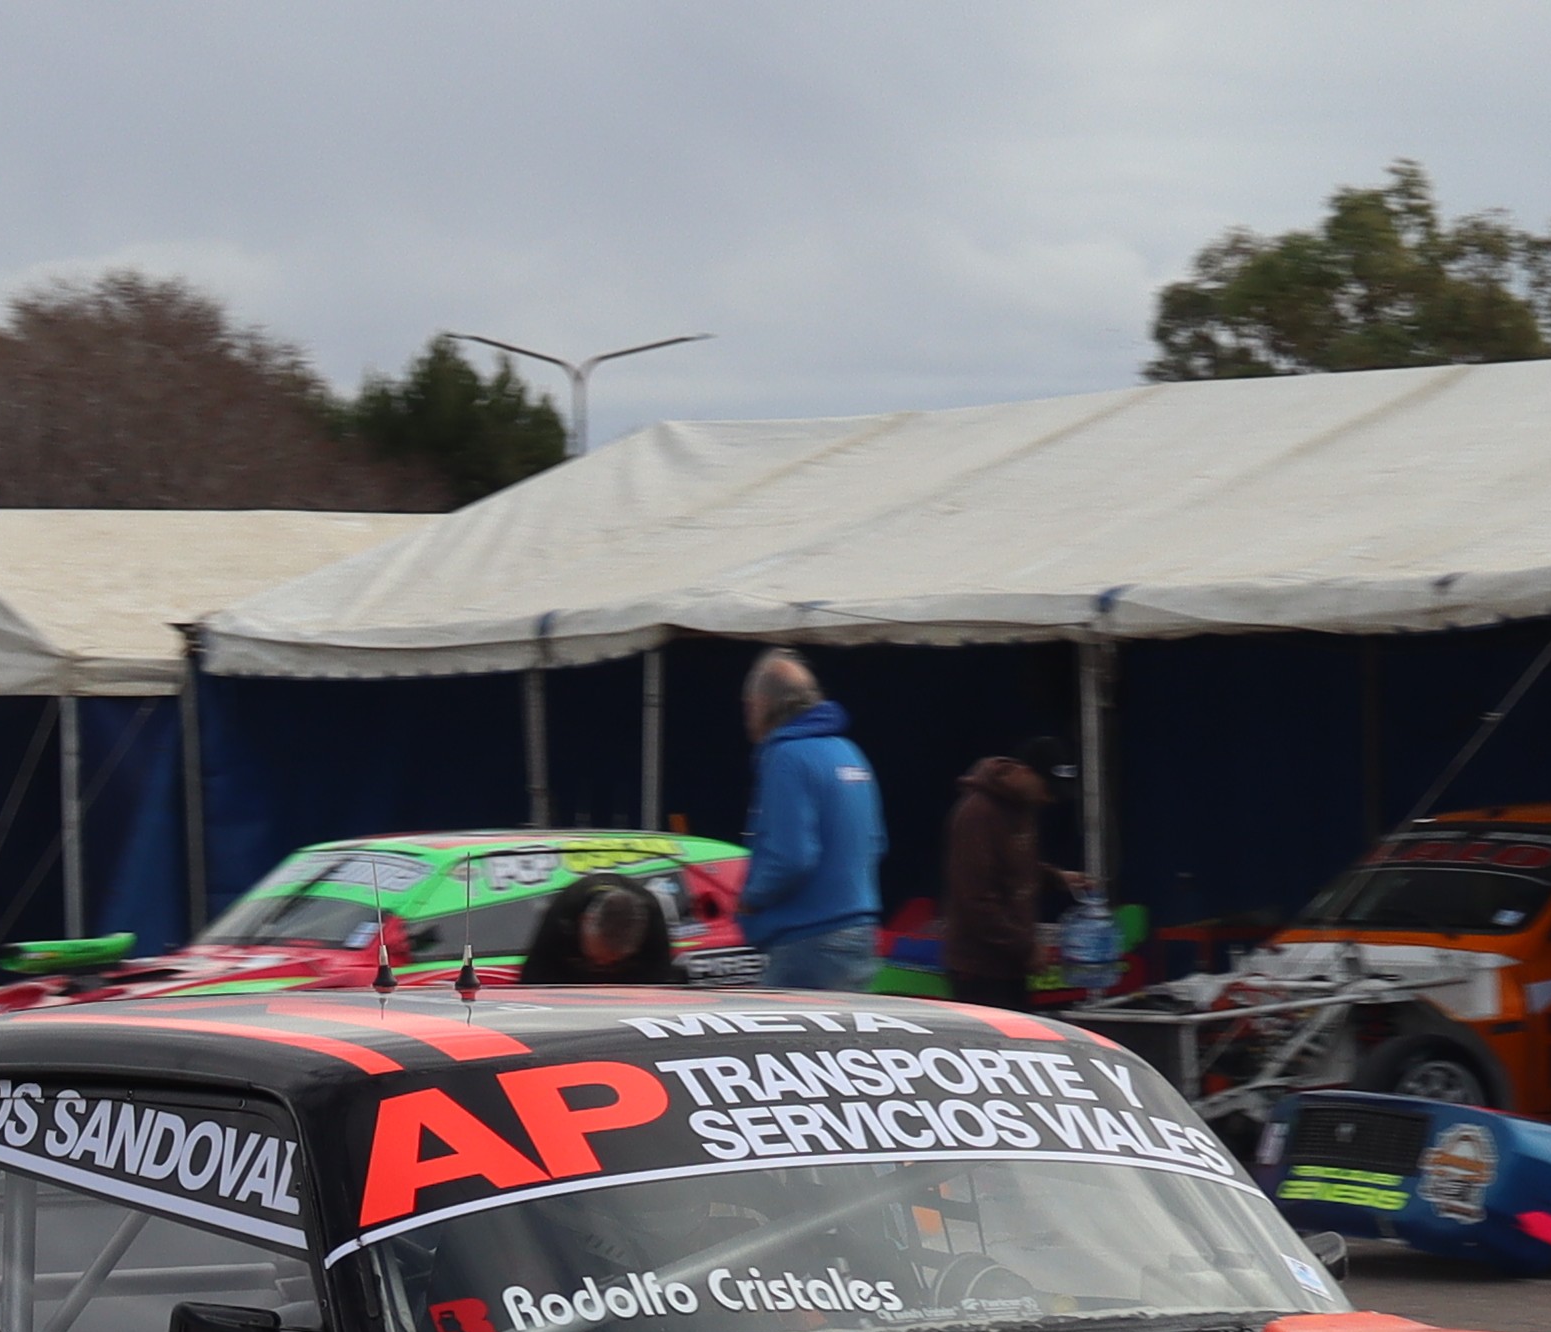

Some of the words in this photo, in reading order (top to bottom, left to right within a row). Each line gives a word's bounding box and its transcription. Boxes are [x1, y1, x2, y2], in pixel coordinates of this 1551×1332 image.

[618, 1010, 934, 1040] META
[654, 1046, 1099, 1107] TRANSPORTE
[1091, 1057, 1144, 1109] Y
[44, 1088, 301, 1216] SANDOVAL
[358, 1060, 669, 1228] AP
[688, 1100, 1042, 1161] SERVICIOS
[1031, 1102, 1237, 1178] VIALES
[501, 1271, 699, 1331] Rodolfo
[707, 1266, 904, 1312] Cristales
